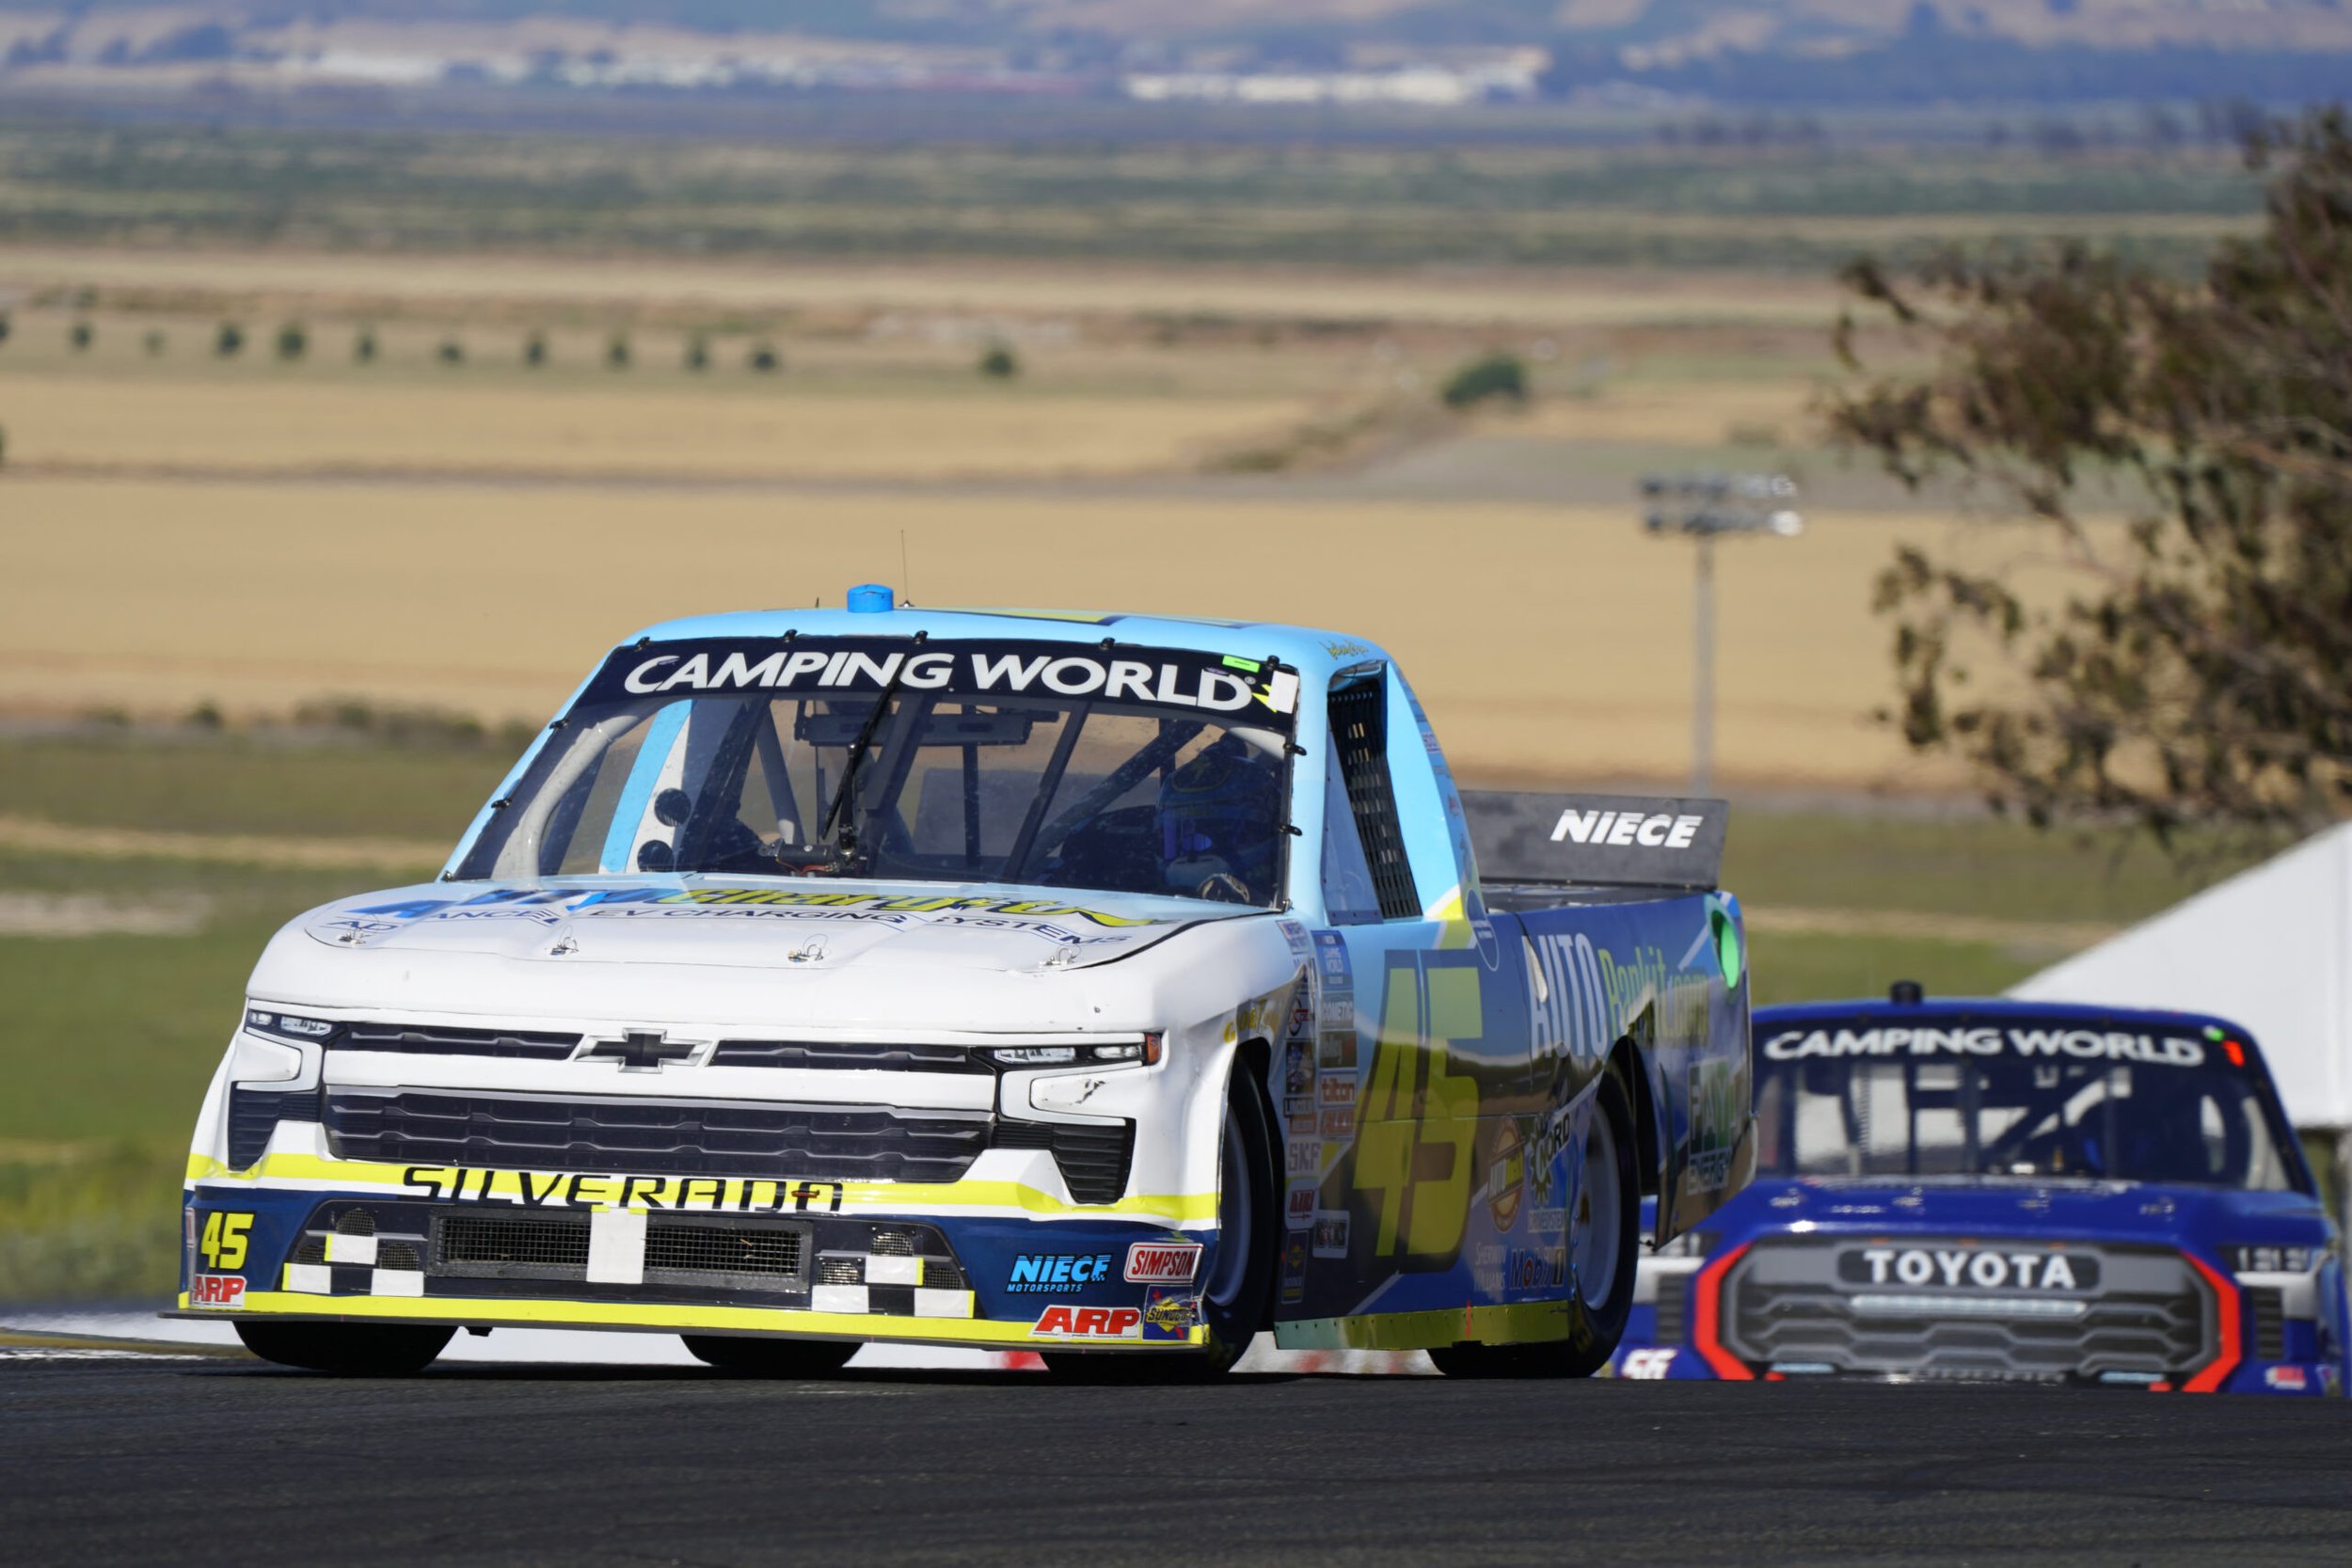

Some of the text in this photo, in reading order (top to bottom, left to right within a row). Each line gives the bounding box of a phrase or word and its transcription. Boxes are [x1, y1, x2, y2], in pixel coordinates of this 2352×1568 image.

[625, 652, 1253, 710] CAMPING WORLD
[1550, 809, 1703, 848] NIECE
[1764, 1027, 2204, 1067] CAMPING WORLD
[1354, 967, 1483, 1258] 45
[403, 1165, 844, 1212] SILVERADO
[200, 1211, 255, 1270] 45
[1010, 1255, 1112, 1282] NIECE
[1132, 1250, 1196, 1276] SIMPSON
[1863, 1249, 2075, 1290] TOYOTA
[194, 1275, 245, 1304] ARP
[1007, 1283, 1083, 1293] MOTORSPORTS
[1035, 1307, 1140, 1335] ARP
